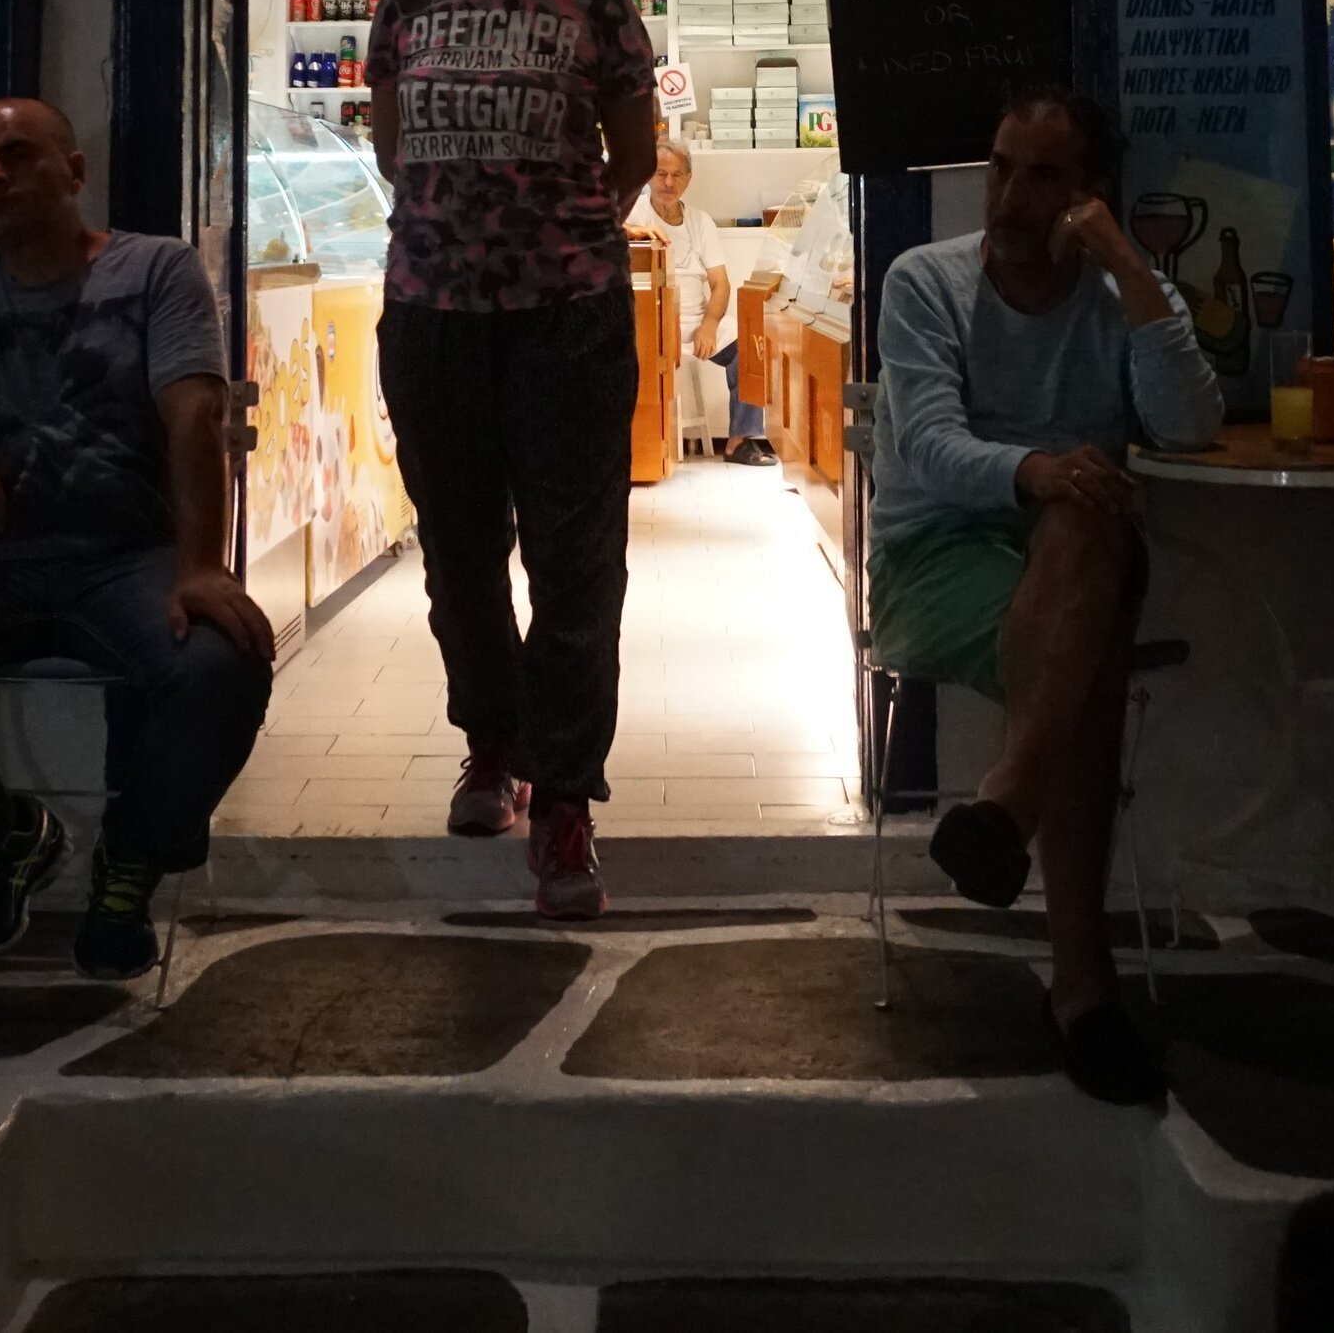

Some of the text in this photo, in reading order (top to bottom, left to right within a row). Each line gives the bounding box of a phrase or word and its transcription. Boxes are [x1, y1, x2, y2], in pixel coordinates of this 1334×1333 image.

[1128, 27, 1251, 57] ΑΝΑΨΥΚΤΙΚΑ
[855, 50, 952, 76] IXED
[808, 111, 832, 132] PG
[1129, 105, 1177, 134] ΠΟΤΑ
